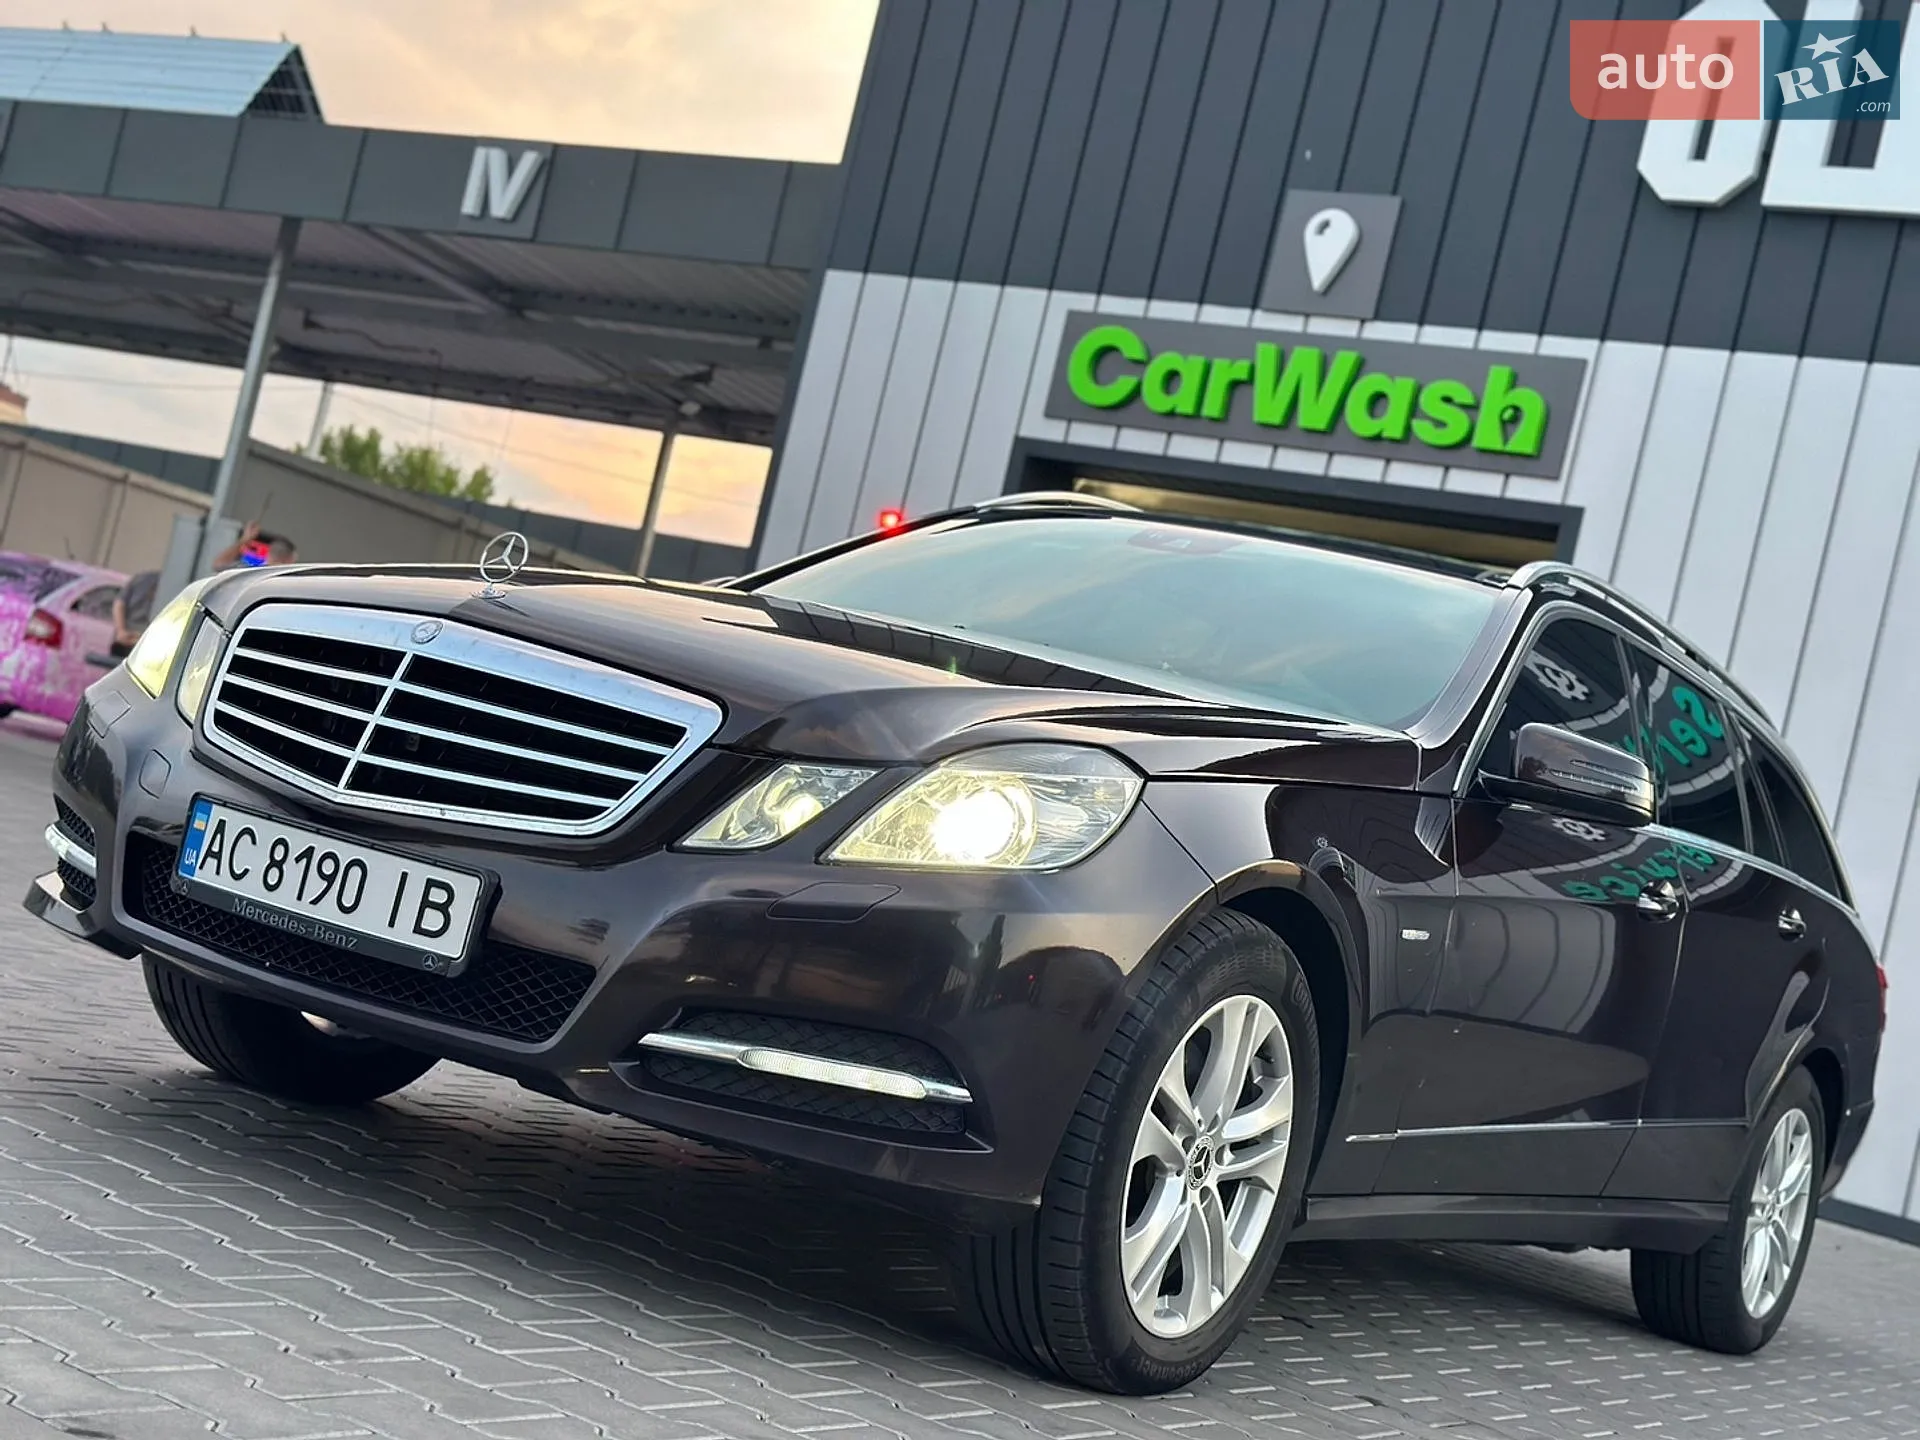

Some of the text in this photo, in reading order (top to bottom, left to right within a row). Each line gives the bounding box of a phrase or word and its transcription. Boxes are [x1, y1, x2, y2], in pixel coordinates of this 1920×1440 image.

[461, 146, 544, 220] IV
[1066, 325, 1549, 458] CarWash
[184, 847, 198, 866] UA
[198, 818, 457, 939] AC 8190 IB
[230, 897, 359, 950] Mercedes-Benz
